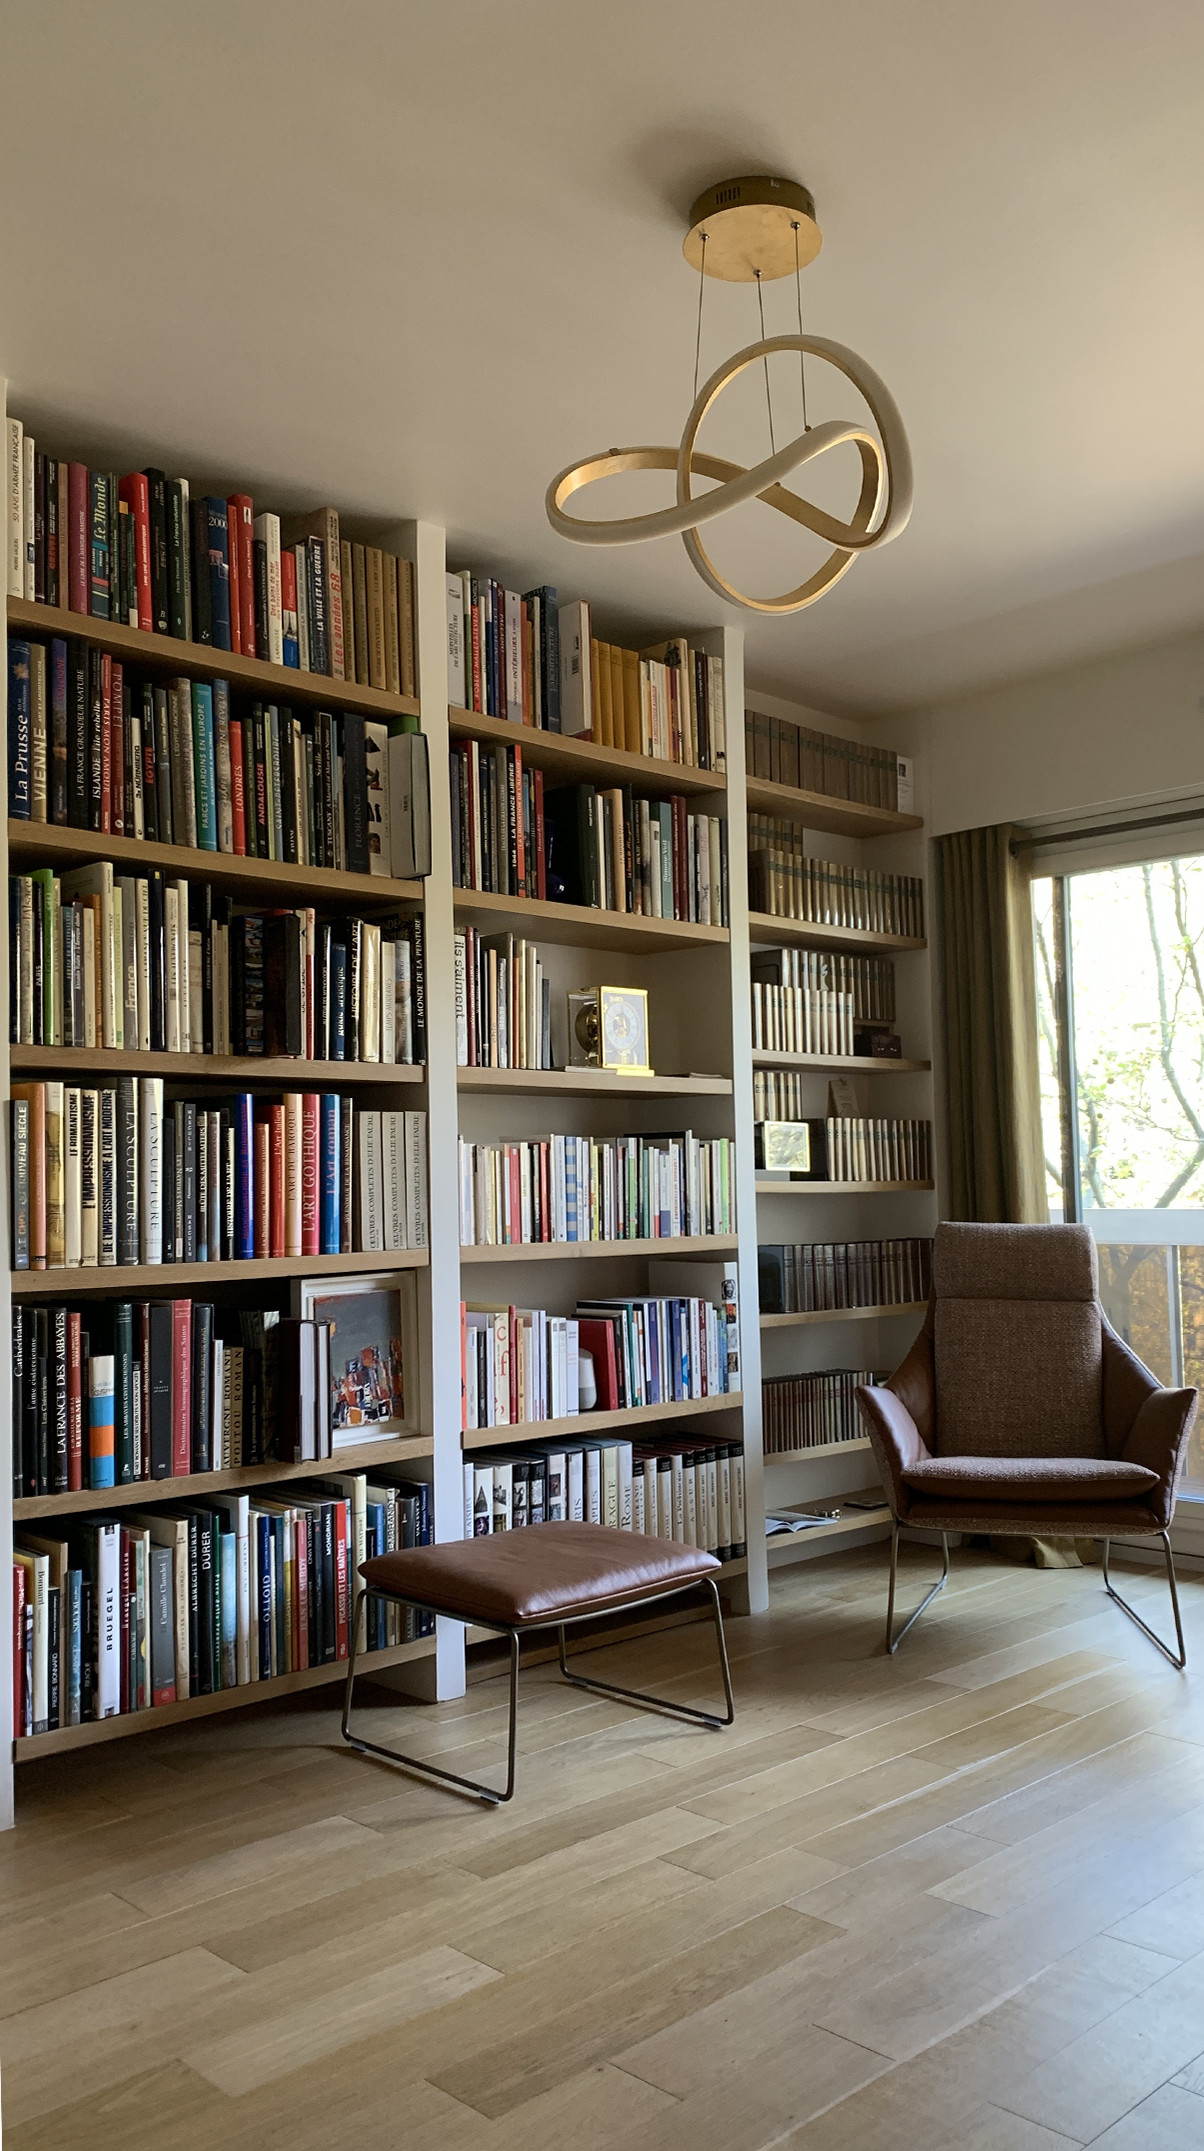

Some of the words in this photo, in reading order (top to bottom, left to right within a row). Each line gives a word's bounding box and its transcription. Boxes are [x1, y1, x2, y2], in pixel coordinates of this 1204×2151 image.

[12, 424, 20, 462] FRANÇAISE
[12, 496, 20, 512] ANS
[93, 477, 106, 524] Monde
[13, 512, 20, 522] 50
[94, 526, 106, 542] Le
[314, 545, 322, 575] GUERRE
[270, 576, 276, 586] de
[315, 577, 322, 586] LA
[315, 588, 322, 598] ET
[330, 573, 341, 592] 68
[316, 621, 324, 632] LA
[331, 596, 342, 639] années
[334, 644, 343, 665] Les
[76, 669, 84, 701] NATURE
[93, 700, 101, 733] rebelle
[197, 704, 205, 737] EUROPE
[14, 714, 28, 774] Prusse
[200, 739, 206, 750] EN
[33, 728, 46, 800] VIENNE
[92, 758, 101, 799] ISLANDE
[133, 745, 141, 789] NÜRNBERG
[145, 747, 154, 784] EGYPTE
[200, 753, 208, 788] JARDINS
[14, 780, 28, 800] La
[77, 784, 84, 796] LA
[201, 790, 208, 800] ET
[235, 765, 243, 812] LONDRES
[257, 762, 265, 825] ANDALOUSIE
[511, 828, 516, 838] LA
[414, 919, 422, 956] PEINTURE
[455, 941, 464, 956] ils
[352, 954, 358, 968] DE
[415, 959, 423, 969] LA
[416, 971, 423, 982] DE
[351, 971, 359, 1018] HISTOIRE
[416, 985, 424, 1016] MONDE
[455, 961, 465, 1019] s'aiment
[417, 1018, 424, 1027] LE
[18, 1107, 26, 1139] SIECLE
[69, 1093, 78, 1146] ROMANTISME
[101, 1092, 112, 1129] MODERNE
[126, 1111, 135, 1129] LA
[150, 1111, 158, 1129] LA
[102, 1131, 112, 1150] L'ART
[327, 1109, 335, 1155] roman
[69, 1147, 78, 1156] LE
[82, 1095, 95, 1209] L'IMPRESSIONNISME
[288, 1158, 295, 1171] DU
[303, 1110, 317, 1188] GOTHIQUE
[126, 1135, 136, 1230] SCULPTURE
[150, 1135, 159, 1230] SCULPTURE
[327, 1160, 335, 1194] L'Art
[345, 1167, 350, 1175] LA
[345, 1177, 350, 1186] DE
[102, 1160, 113, 1240] L'IMPRESSIONNISME
[227, 1186, 233, 1198] DE
[303, 1192, 316, 1231] L'ART
[102, 1243, 113, 1253] DE
[14, 1315, 23, 1377] Cathédrales
[56, 1313, 65, 1360] ABBAYES
[56, 1364, 65, 1385] DES
[180, 1360, 188, 1410] iconographique
[56, 1391, 65, 1436] FRANCE
[57, 1437, 66, 1454] LA
[223, 1405, 231, 1466] AUVERGNE
[621, 1485, 631, 1528] ROME
[677, 1513, 682, 1525] La
[190, 1526, 198, 1558] DÜRER
[201, 1531, 211, 1570] DÜRER
[337, 1539, 345, 1568] MAÎTRES
[16, 1570, 25, 1614] Jean-Michel
[37, 1571, 45, 1606] Bonnard
[263, 1575, 271, 1622] GIOTTO
[339, 1583, 345, 1592] ET
[106, 1587, 114, 1651] BRUEGEL
